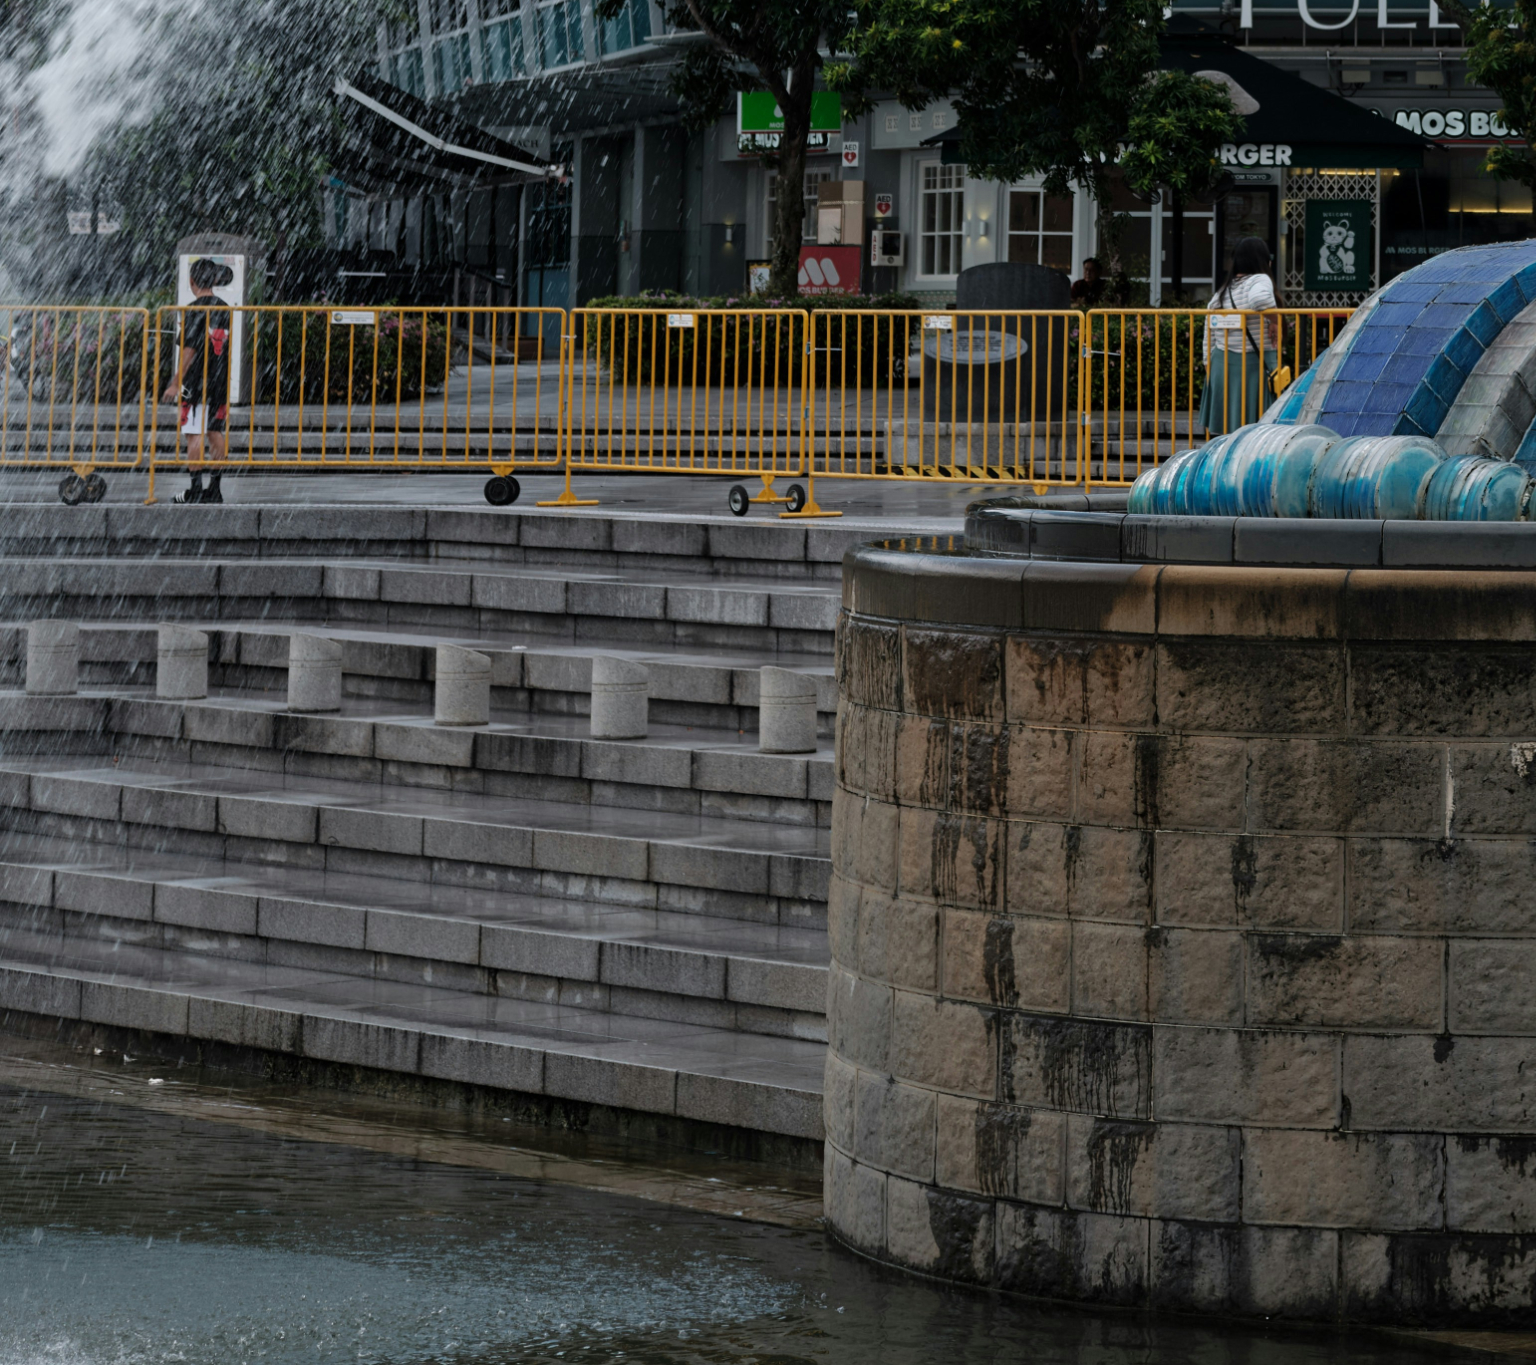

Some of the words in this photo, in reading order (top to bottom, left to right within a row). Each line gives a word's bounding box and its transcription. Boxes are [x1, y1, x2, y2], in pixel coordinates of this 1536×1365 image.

[1396, 111, 1465, 137] MOS
[1214, 142, 1293, 166] RGER
[1397, 246, 1417, 255] MOS
